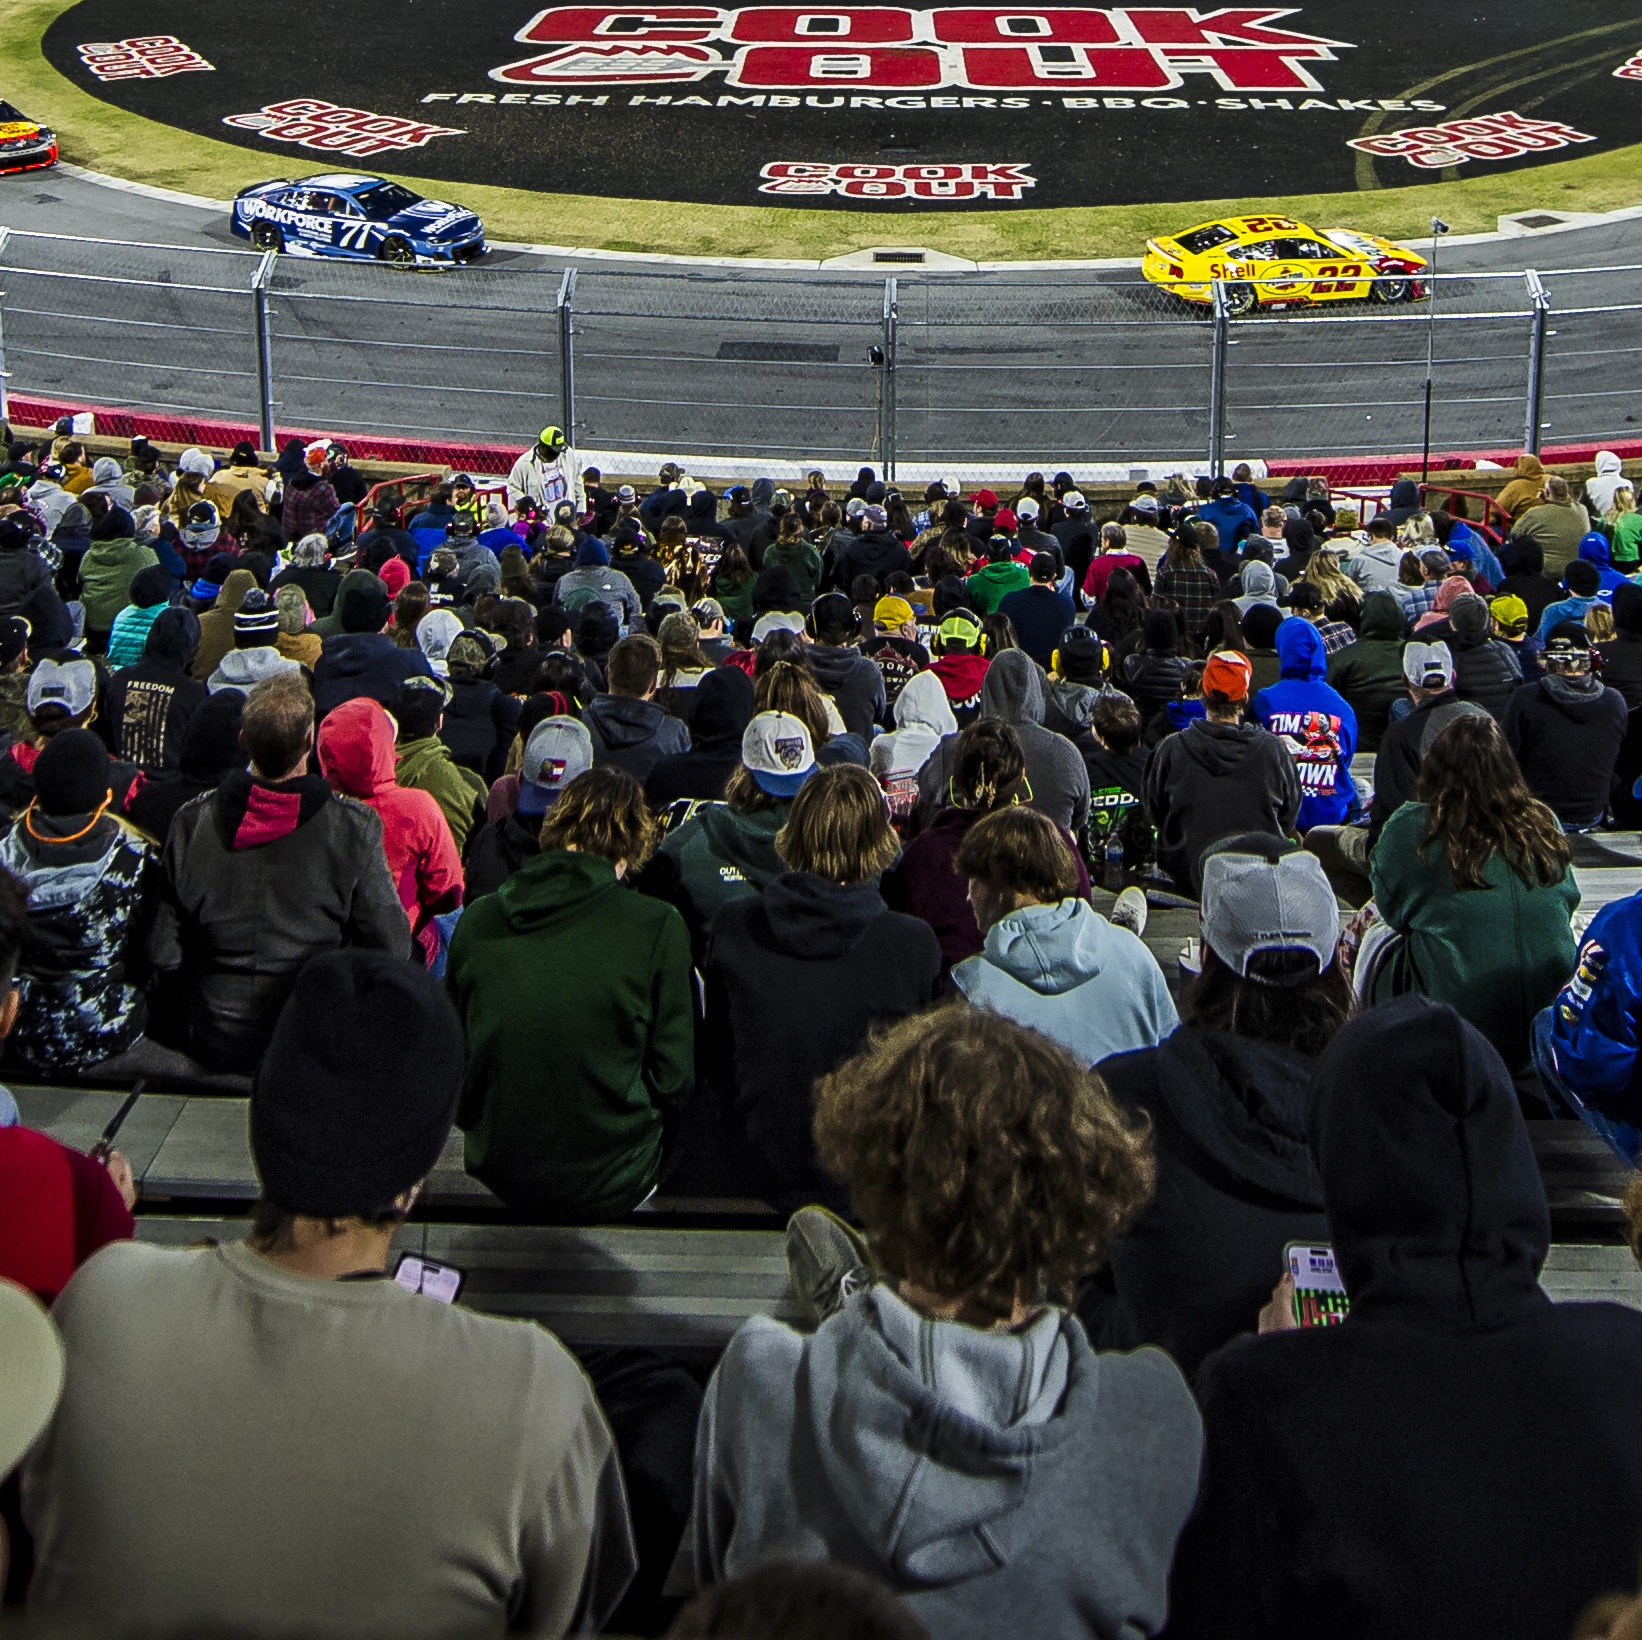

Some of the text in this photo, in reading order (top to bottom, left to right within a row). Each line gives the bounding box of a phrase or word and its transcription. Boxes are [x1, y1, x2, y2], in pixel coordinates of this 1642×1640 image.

[514, 6, 1357, 48] COOK
[81, 52, 157, 81] OUT
[120, 36, 216, 77] COOK
[724, 44, 1339, 92] OUT
[420, 93, 1447, 112] FRESH HAMBURGERS BBQ SHAKES
[262, 99, 467, 146] COOK
[1346, 111, 1549, 156] COOK
[259, 121, 412, 157] OUT
[1457, 125, 1597, 160] OUT
[759, 161, 1038, 182] COOK
[837, 179, 1036, 201] OUT
[243, 199, 333, 234] WORKFORCE
[338, 222, 373, 249] 71
[1210, 262, 1256, 280] Shell
[1310, 265, 1362, 294] 22
[127, 680, 175, 695] FREEDOM
[1269, 712, 1304, 734] TIM
